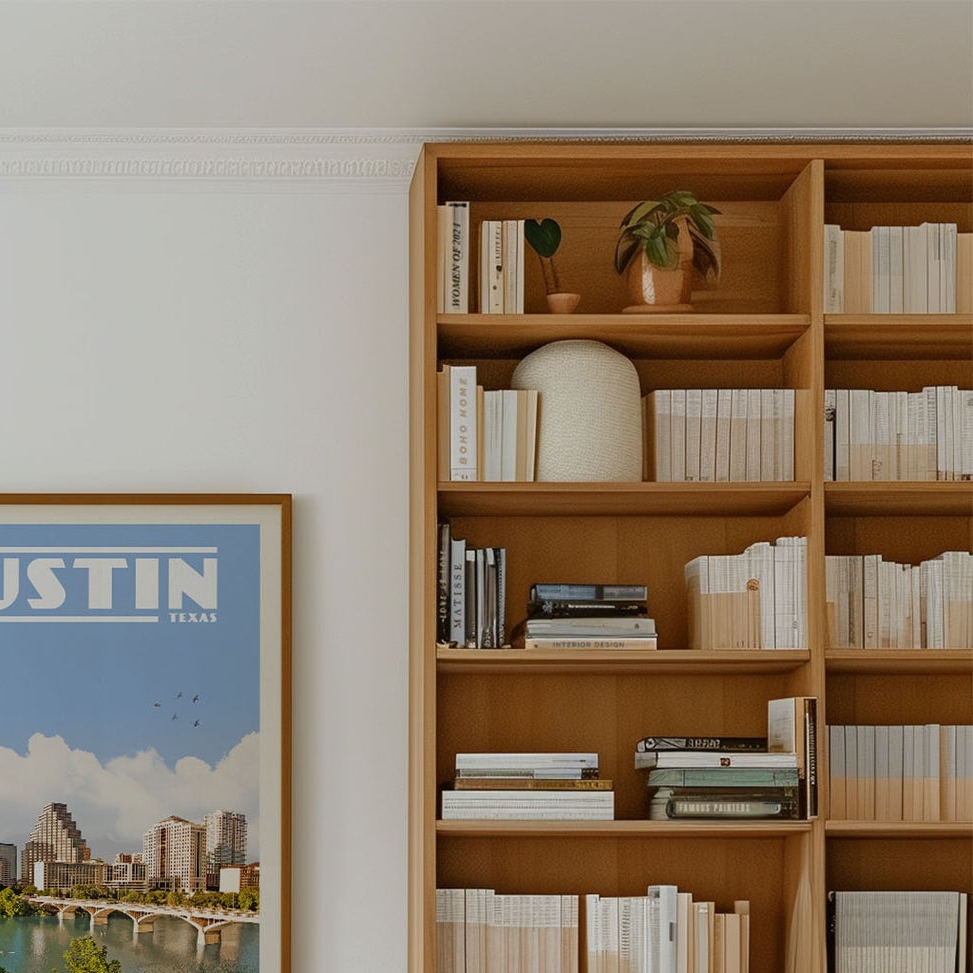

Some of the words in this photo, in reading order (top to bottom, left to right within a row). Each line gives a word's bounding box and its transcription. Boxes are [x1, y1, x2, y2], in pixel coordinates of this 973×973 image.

[452, 247, 460, 262] OF
[452, 263, 460, 307] WOMEN
[459, 377, 467, 418] HOME
[459, 425, 467, 465] BOHO
[453, 564, 462, 629] MATISSE
[169, 612, 217, 623] TEXAS
[552, 641, 591, 649] INTERIOR
[594, 641, 625, 649] DESIGN
